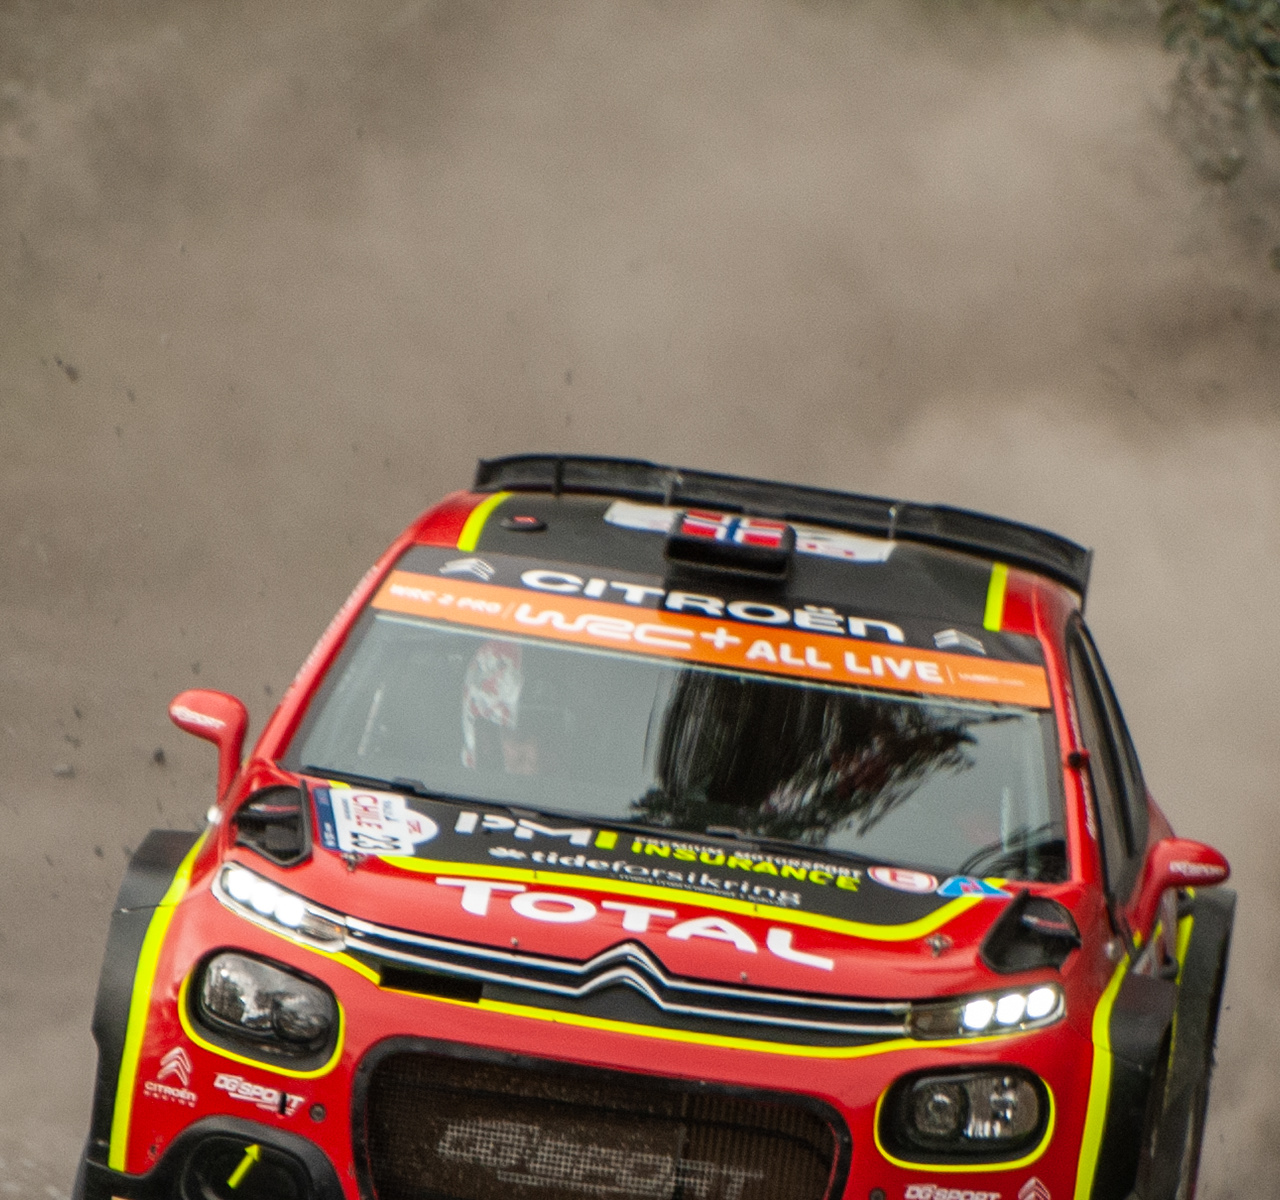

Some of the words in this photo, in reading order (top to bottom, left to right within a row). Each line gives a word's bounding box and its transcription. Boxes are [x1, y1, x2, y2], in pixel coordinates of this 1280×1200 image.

[745, 639, 832, 670] ALL
[844, 652, 943, 684] LIVE
[631, 841, 861, 892] INSURANCE
[435, 876, 835, 972] TOTAL
